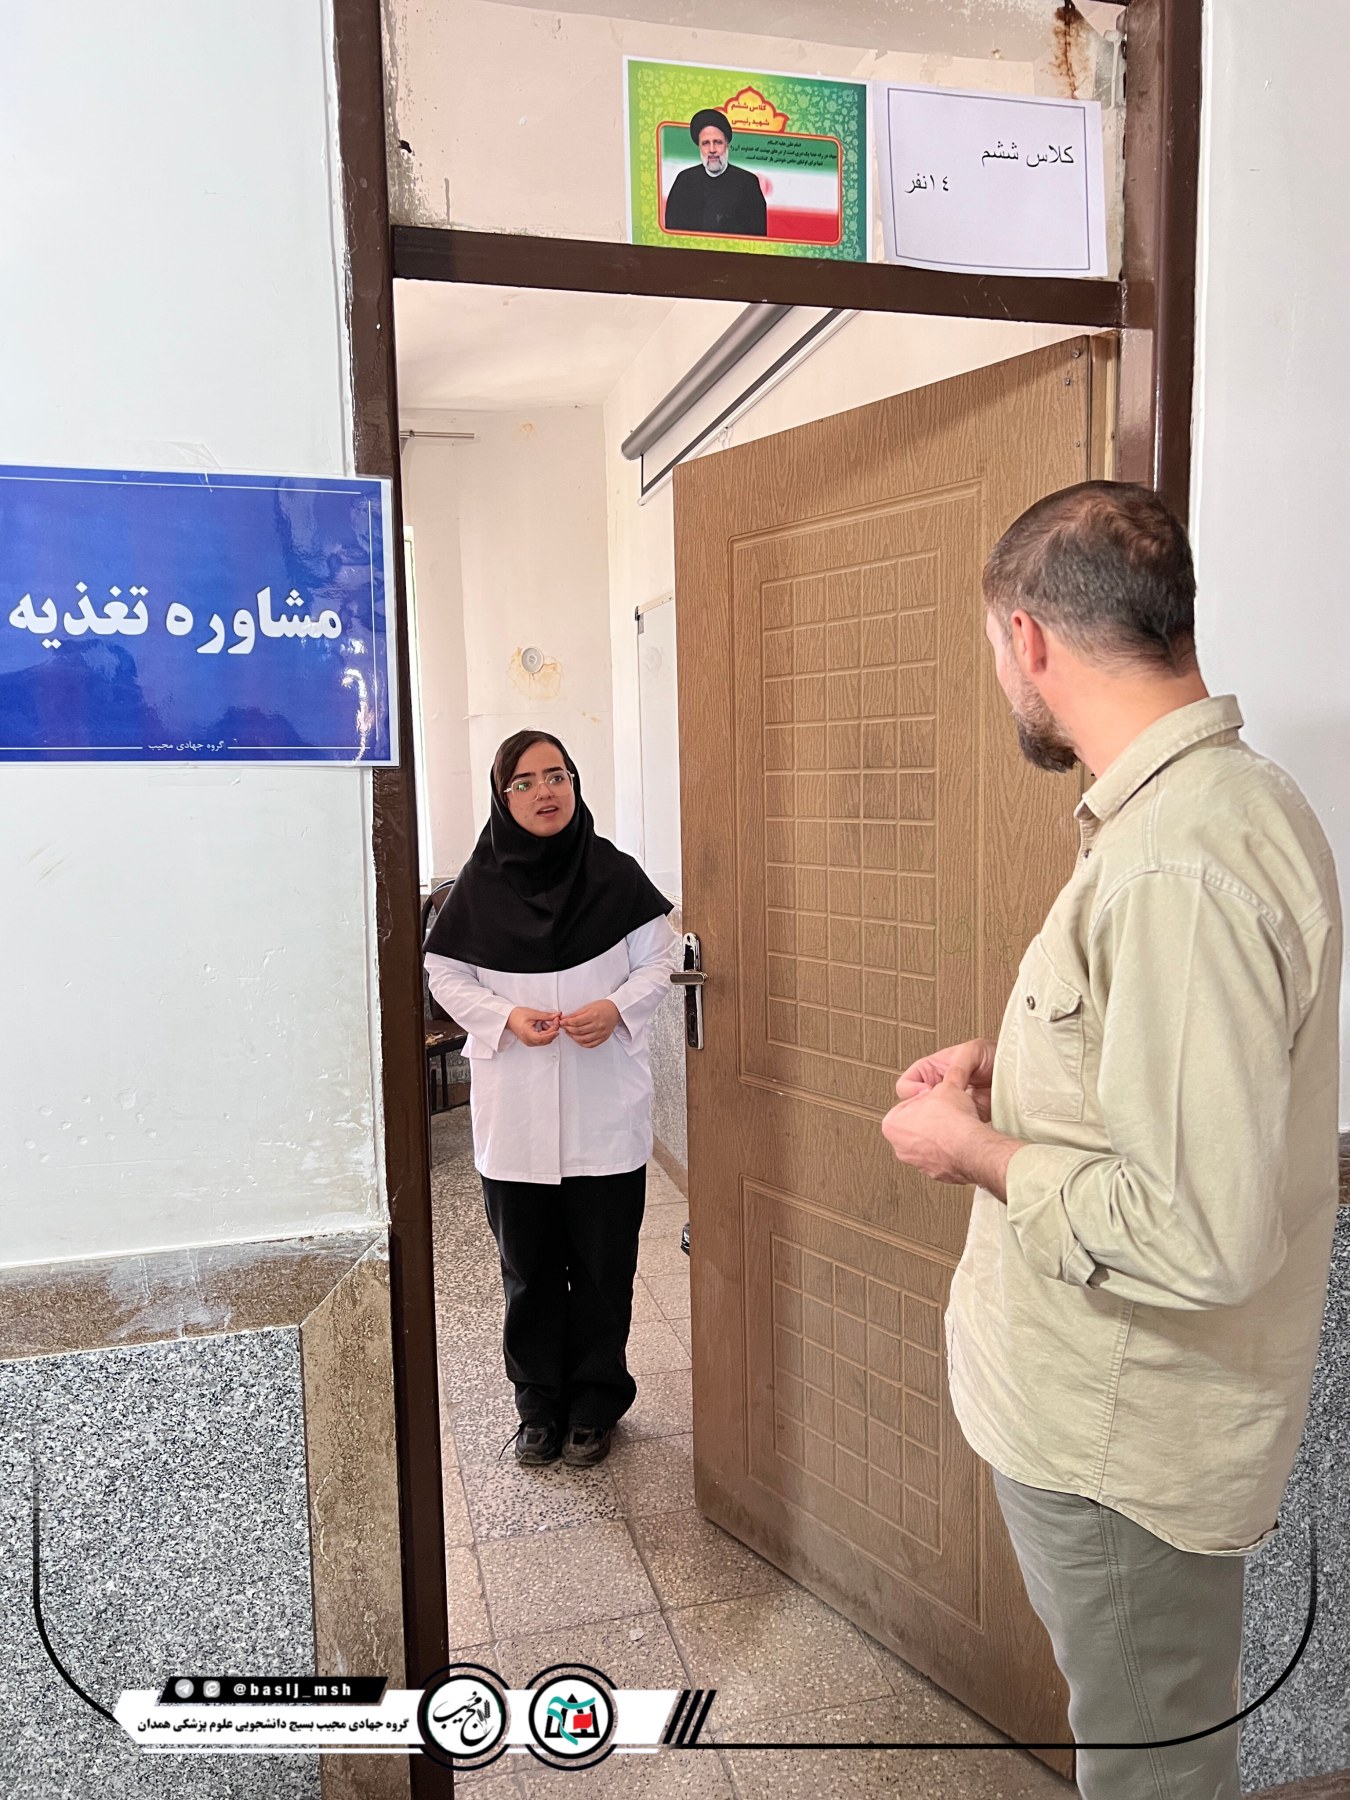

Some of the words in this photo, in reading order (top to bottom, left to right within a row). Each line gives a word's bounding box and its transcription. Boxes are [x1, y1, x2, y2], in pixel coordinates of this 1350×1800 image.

[731, 102, 749, 111] ششم
[749, 104, 766, 112] کلاس
[752, 118, 769, 127] شهید
[981, 140, 1019, 168] ششم
[1026, 145, 1074, 168] کلاس
[8, 581, 149, 649] تغذیه
[165, 587, 343, 654] مشاوره
[148, 743, 174, 751] مجیب
[176, 740, 204, 752] جهادی
[206, 740, 225, 752] گروه
